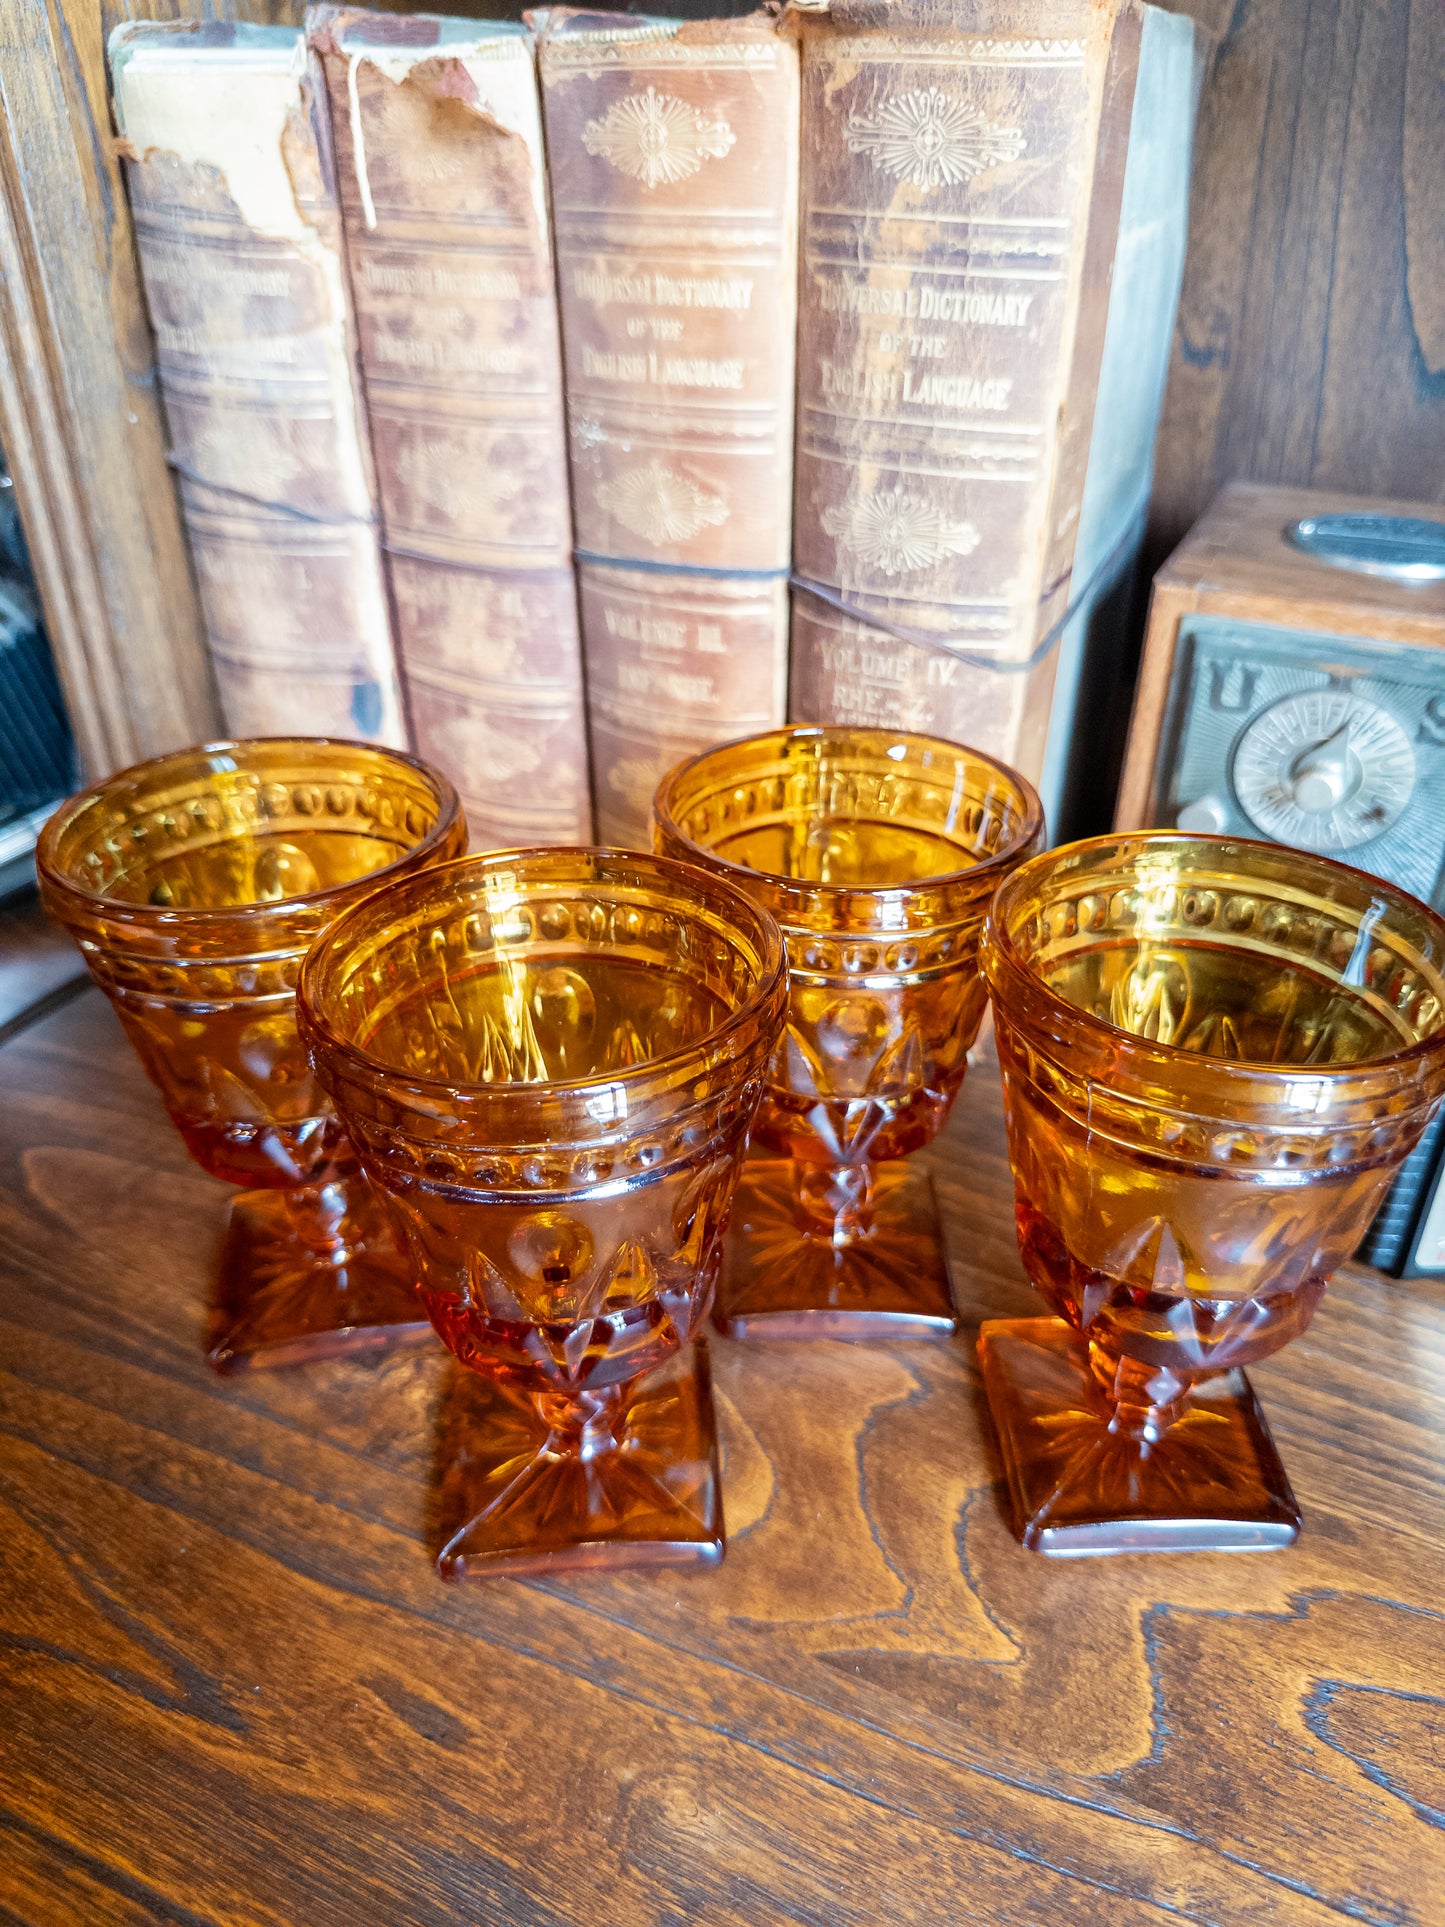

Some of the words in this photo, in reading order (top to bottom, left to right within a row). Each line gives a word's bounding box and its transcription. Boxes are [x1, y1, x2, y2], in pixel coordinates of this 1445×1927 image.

[921, 287, 1031, 325] DICTIONARY
[879, 330, 901, 352] OF
[909, 334, 947, 359] THE
[820, 358, 898, 400] ENGLISH
[903, 371, 1012, 410] LANGUAGE
[822, 644, 912, 680] VOLUME
[927, 657, 961, 687] IV.
